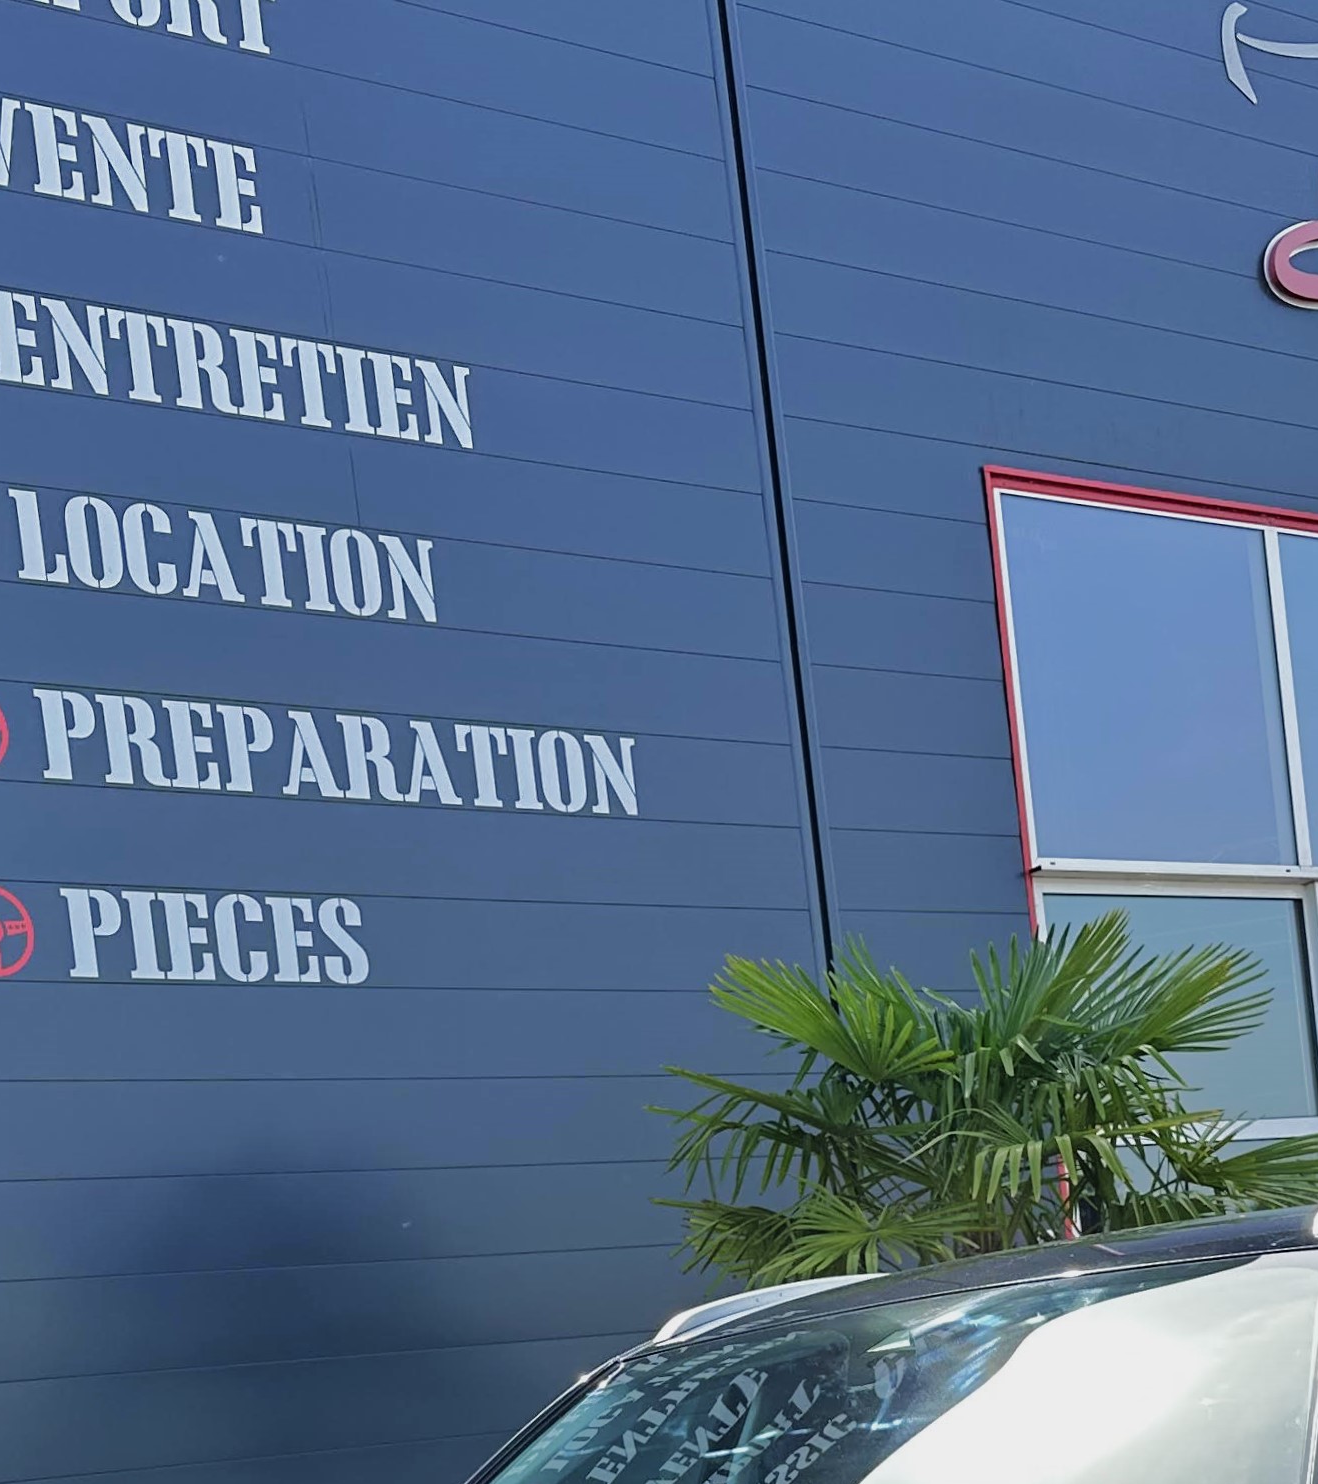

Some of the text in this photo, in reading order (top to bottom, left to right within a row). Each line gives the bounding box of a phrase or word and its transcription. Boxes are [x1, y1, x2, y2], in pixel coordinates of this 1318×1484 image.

[8, 488, 438, 623] LOCATION
[32, 688, 638, 816] PREPARATION
[59, 887, 369, 985] PIECES
